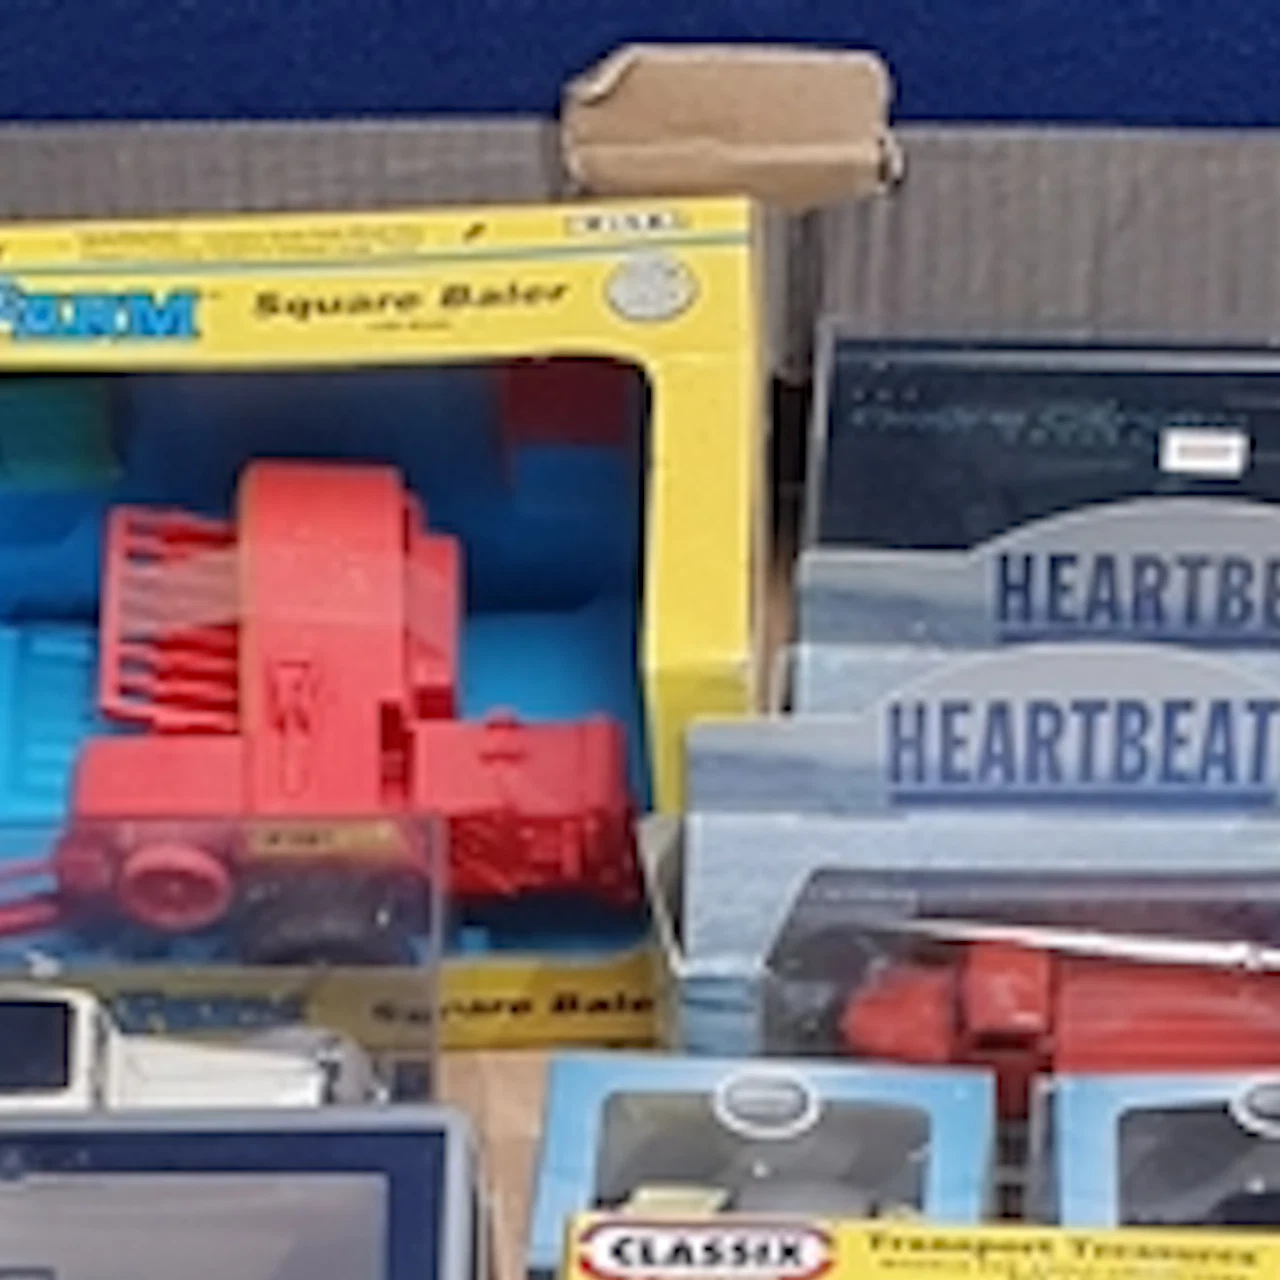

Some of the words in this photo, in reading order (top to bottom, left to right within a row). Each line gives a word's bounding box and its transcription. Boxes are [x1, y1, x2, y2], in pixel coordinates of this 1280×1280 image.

[252, 290, 420, 321] Square
[438, 280, 572, 308] Baler
[548, 991, 655, 1014] Bale
[609, 1235, 802, 1267] CLASSIX
[866, 1230, 1056, 1264] Transport
[1068, 1236, 1260, 1267] Treasures
